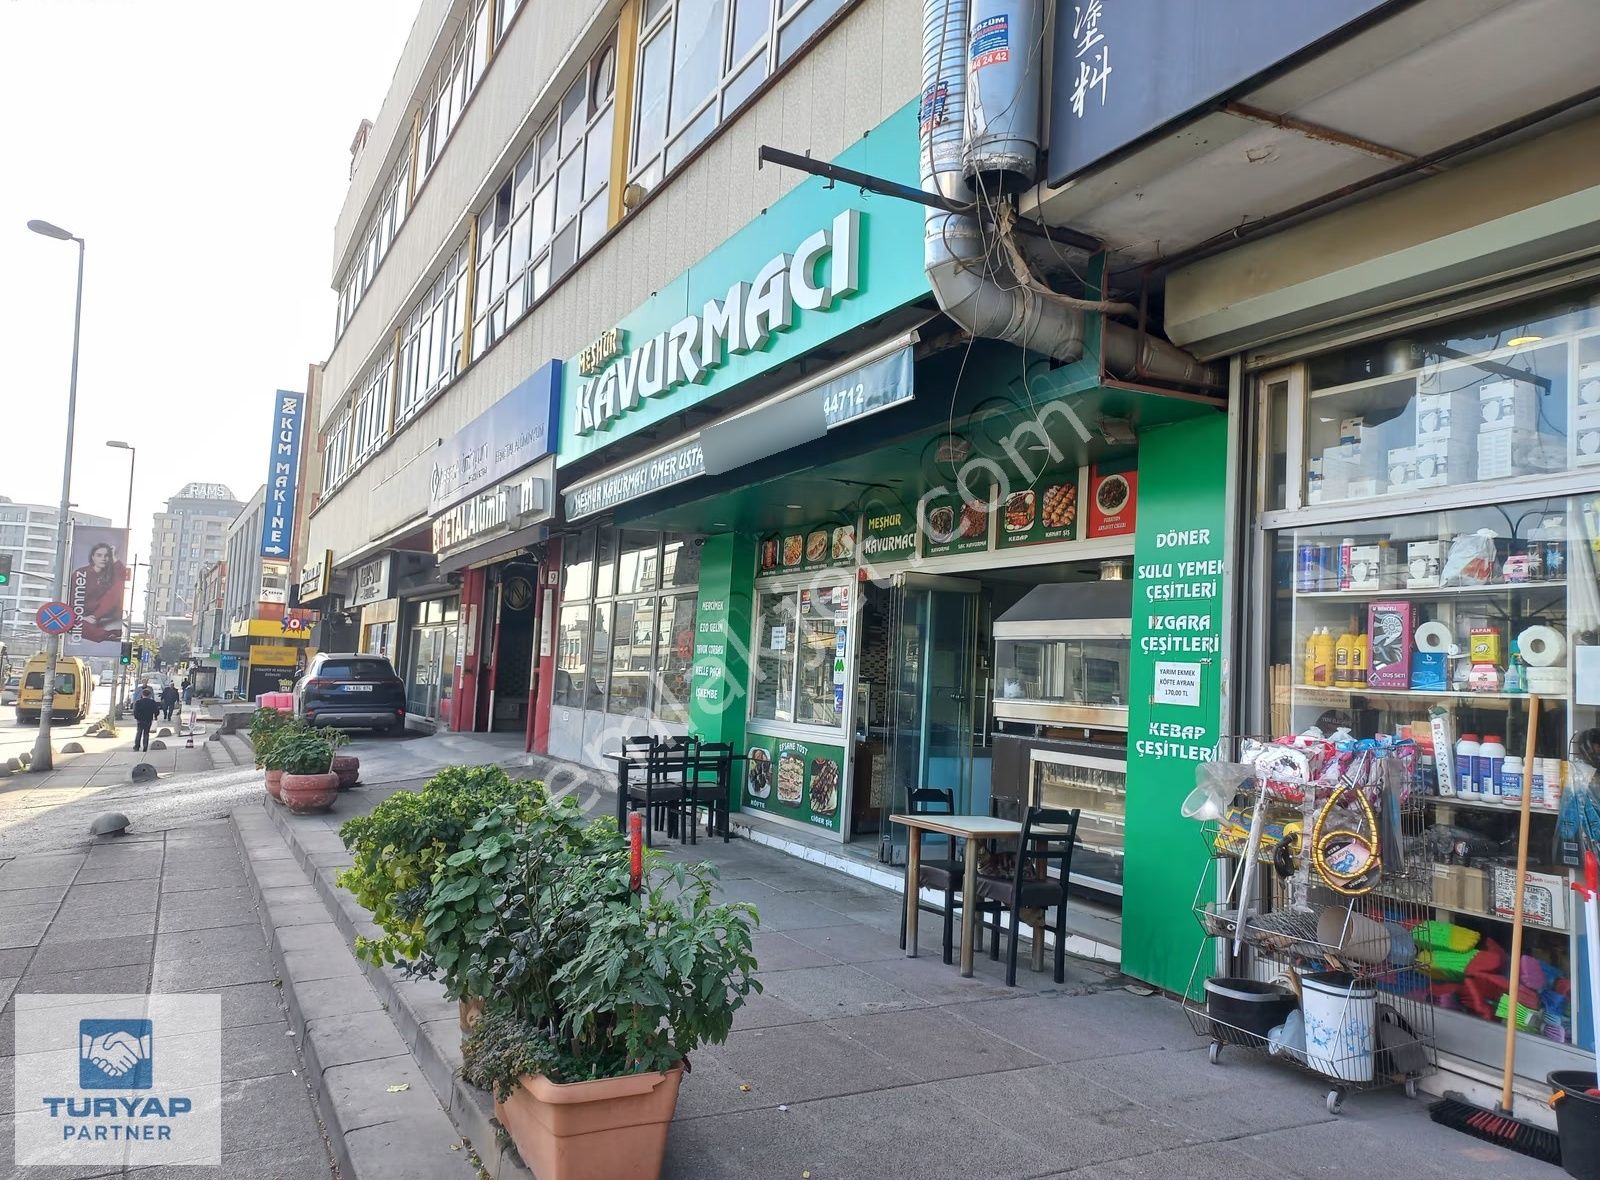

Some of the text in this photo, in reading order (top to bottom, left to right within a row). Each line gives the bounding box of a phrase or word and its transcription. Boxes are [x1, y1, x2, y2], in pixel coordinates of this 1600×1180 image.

[995, 51, 1007, 61] 42
[575, 208, 861, 436] KAVURMACI
[271, 417, 293, 542] KUM MAKİNE
[602, 468, 647, 499] KAVURMACI
[651, 458, 677, 481] ÖMER
[679, 447, 704, 470] USTA
[868, 513, 901, 531] MEŞHUR
[865, 532, 917, 554] KAVURMACI
[1156, 529, 1210, 548] DÖNER
[1138, 563, 1173, 579] SULU
[1146, 579, 1217, 602] ÇEŞİTLERİ
[1148, 615, 1211, 631] IZGARA
[1141, 633, 1219, 655] ÇEŞİTLERİ
[1160, 678, 1175, 686] KÖFTE
[1149, 722, 1206, 740] KEBAP
[1136, 740, 1218, 762] ÇEŞİTLERİ
